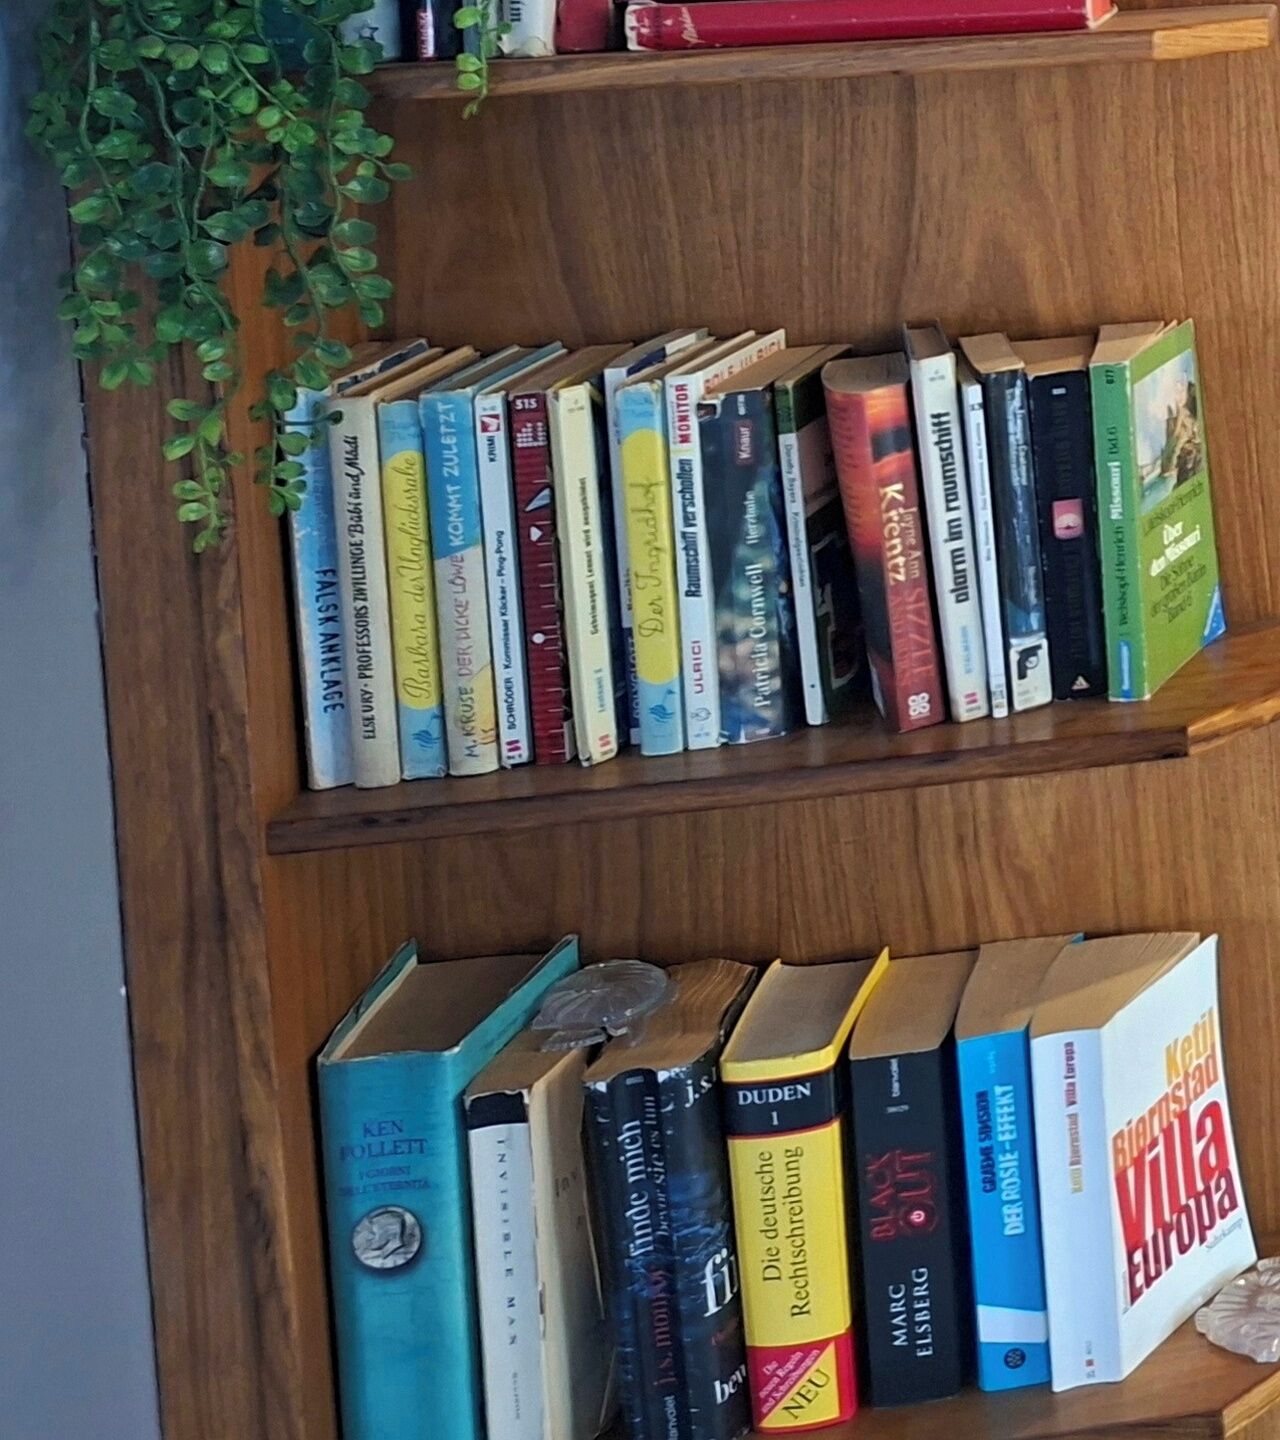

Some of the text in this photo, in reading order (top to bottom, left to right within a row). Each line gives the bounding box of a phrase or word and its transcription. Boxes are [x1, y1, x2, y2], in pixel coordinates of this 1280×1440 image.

[437, 402, 460, 478] ZULETZT
[674, 383, 692, 445] MONITOR
[738, 426, 751, 460] Knaur
[484, 436, 498, 462] KRIMI
[393, 456, 429, 573] Unglücksrabe
[447, 485, 465, 547] KOMMT
[930, 411, 970, 603] alarm im raumschiff
[1107, 461, 1123, 520] Missouri
[494, 530, 508, 577] Ping-Pong
[879, 482, 907, 585] Krentz
[897, 506, 922, 579] Jayne Ann
[314, 567, 339, 626] FALSK
[448, 554, 468, 595] LÖWE
[678, 458, 705, 695] ULRICI Raumschiff verschollen
[745, 563, 767, 639] Cornwell
[319, 632, 345, 713] ANKLAGE
[350, 541, 377, 740] ELSE URY PROFESSORS ZWILLINGE
[403, 613, 431, 699] Barbara
[456, 644, 473, 677] DER
[502, 619, 514, 670] Kommissar
[751, 640, 771, 708] Patricia
[458, 687, 475, 738] KRUSE
[1063, 1040, 1077, 1080] Europa
[1164, 1006, 1217, 1087] Ketil
[738, 1083, 812, 1105] DUDEN
[771, 1111, 779, 1126] 1
[1063, 1081, 1078, 1109] Villa
[340, 1138, 428, 1160] FOLLETT
[362, 1119, 404, 1139] KEN
[617, 1120, 647, 1184] mich
[646, 1154, 666, 1185] sie
[865, 1149, 897, 1242] BLACK
[1114, 1098, 1231, 1256] Villa
[495, 1138, 518, 1346] INVISIBLE MAN
[754, 1151, 782, 1282] Die deutsche
[782, 1145, 811, 1318] Rechtschreibung
[1002, 1201, 1026, 1237] DER
[1126, 1167, 1240, 1307] Europa
[888, 1283, 910, 1347] MARC
[911, 1267, 935, 1357] ELSBERG
[780, 1368, 831, 1420] NEU
